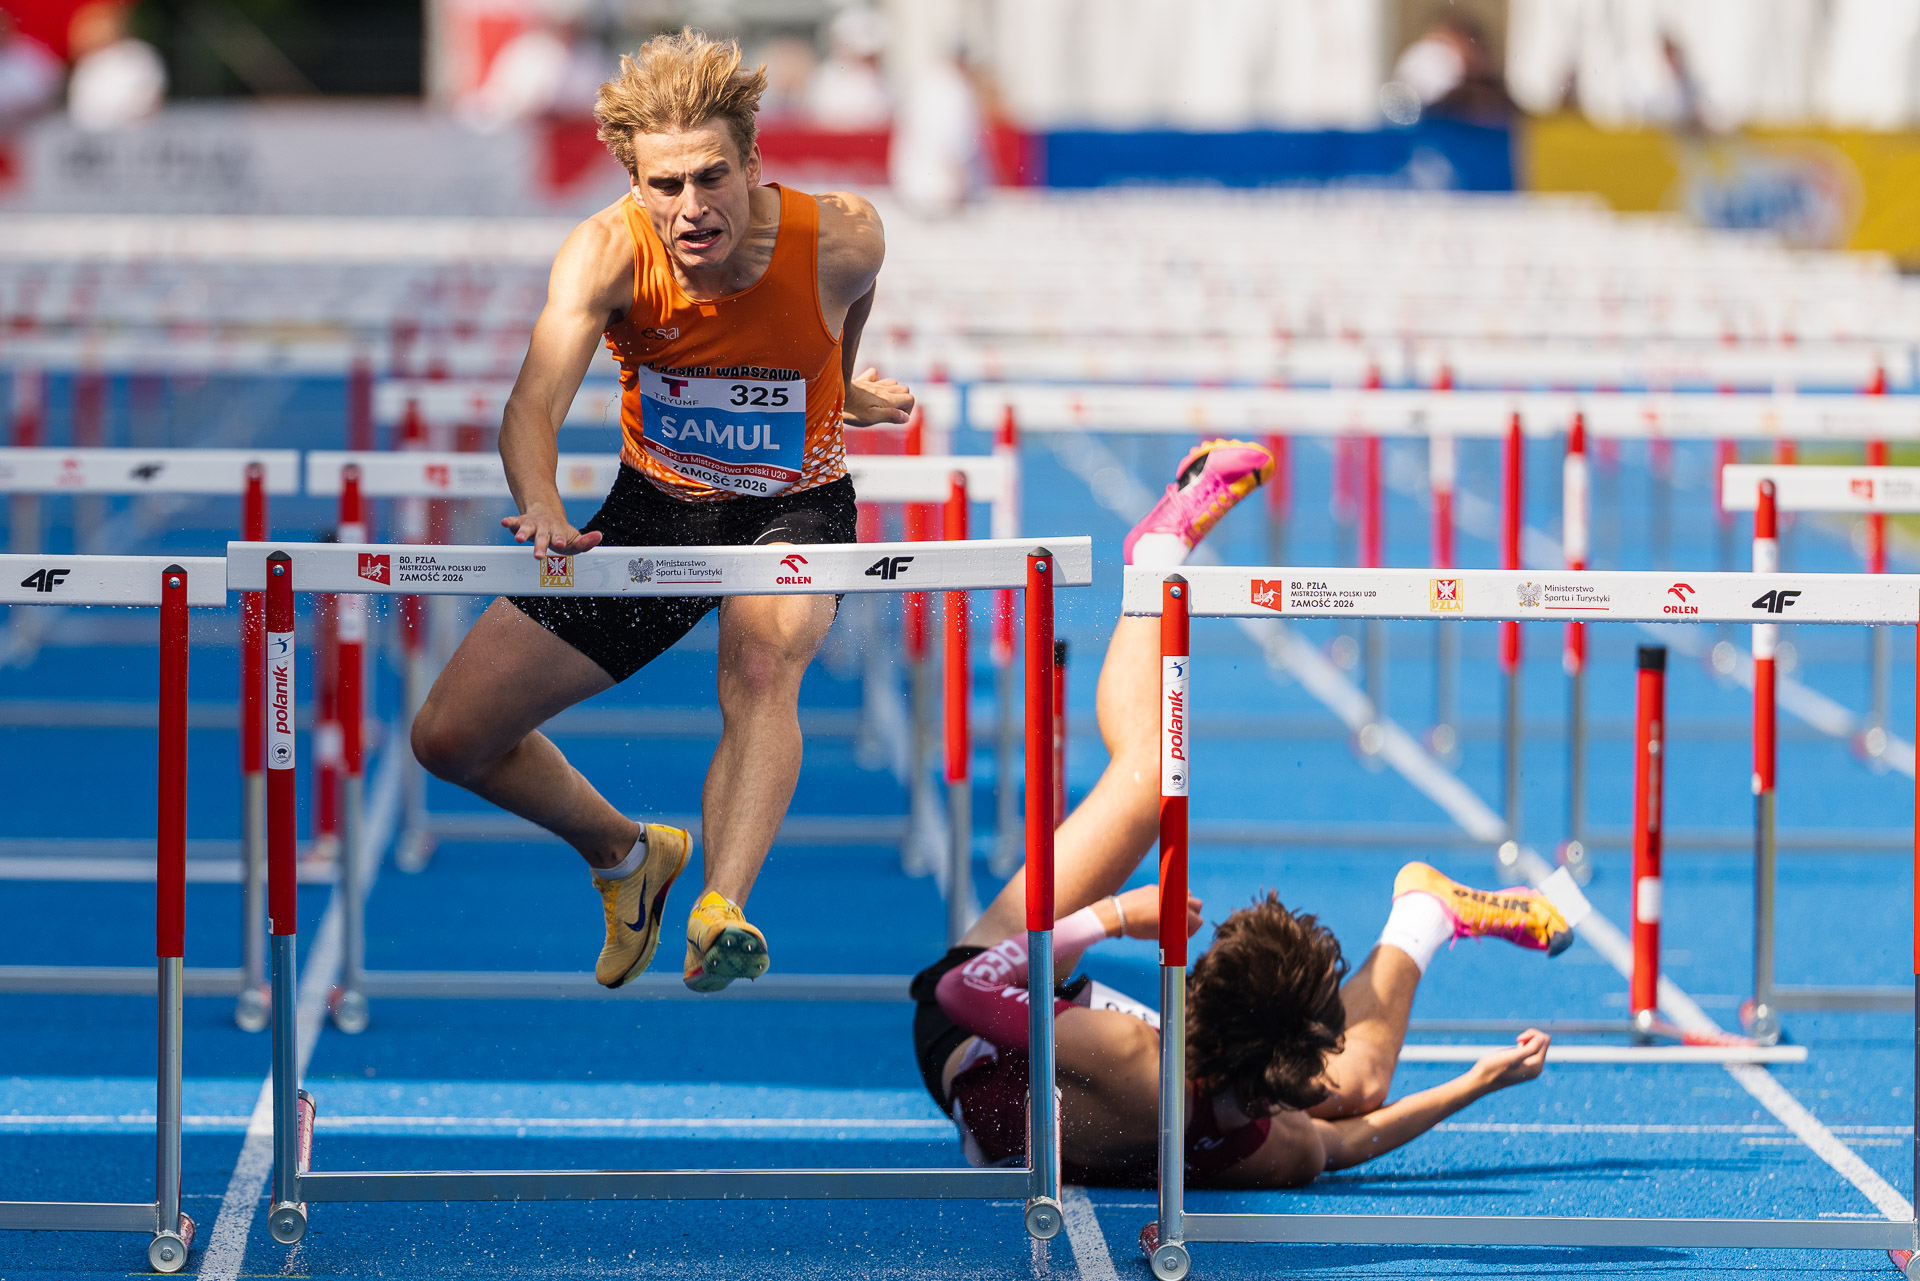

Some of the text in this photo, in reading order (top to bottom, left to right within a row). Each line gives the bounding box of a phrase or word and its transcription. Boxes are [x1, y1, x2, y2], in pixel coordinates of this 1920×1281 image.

[653, 391, 700, 406] TRYUMF
[730, 385, 789, 407] 325
[661, 415, 780, 450] SAMUL
[690, 456, 741, 474] Mistrzostwa
[743, 466, 769, 477] Polski
[770, 470, 787, 480] U20
[672, 462, 768, 493] ZAMOŚĆ 2026
[399, 556, 436, 564] 80. PZLA
[656, 559, 707, 567] Ministerstwo
[656, 568, 681, 577] Sportu
[688, 568, 723, 578] Turystyki
[865, 556, 915, 580] 4F
[21, 568, 71, 592] 4F
[399, 572, 464, 582] ZAMOŚĆ 2026
[541, 576, 573, 586] PZLA
[776, 576, 812, 585] ORLEN
[1290, 582, 1328, 590] 80. PZLA
[1544, 584, 1595, 593] Ministerstwo
[1291, 598, 1355, 608] ZAMOŚĆ 2026
[1544, 593, 1570, 603] Sportu
[1576, 594, 1611, 604] Turystyki
[1752, 589, 1802, 614] 4F
[1431, 600, 1462, 611] PZLA
[1663, 605, 1698, 615] ORLEN
[272, 664, 292, 735] polanik
[1167, 689, 1186, 762] polanik
